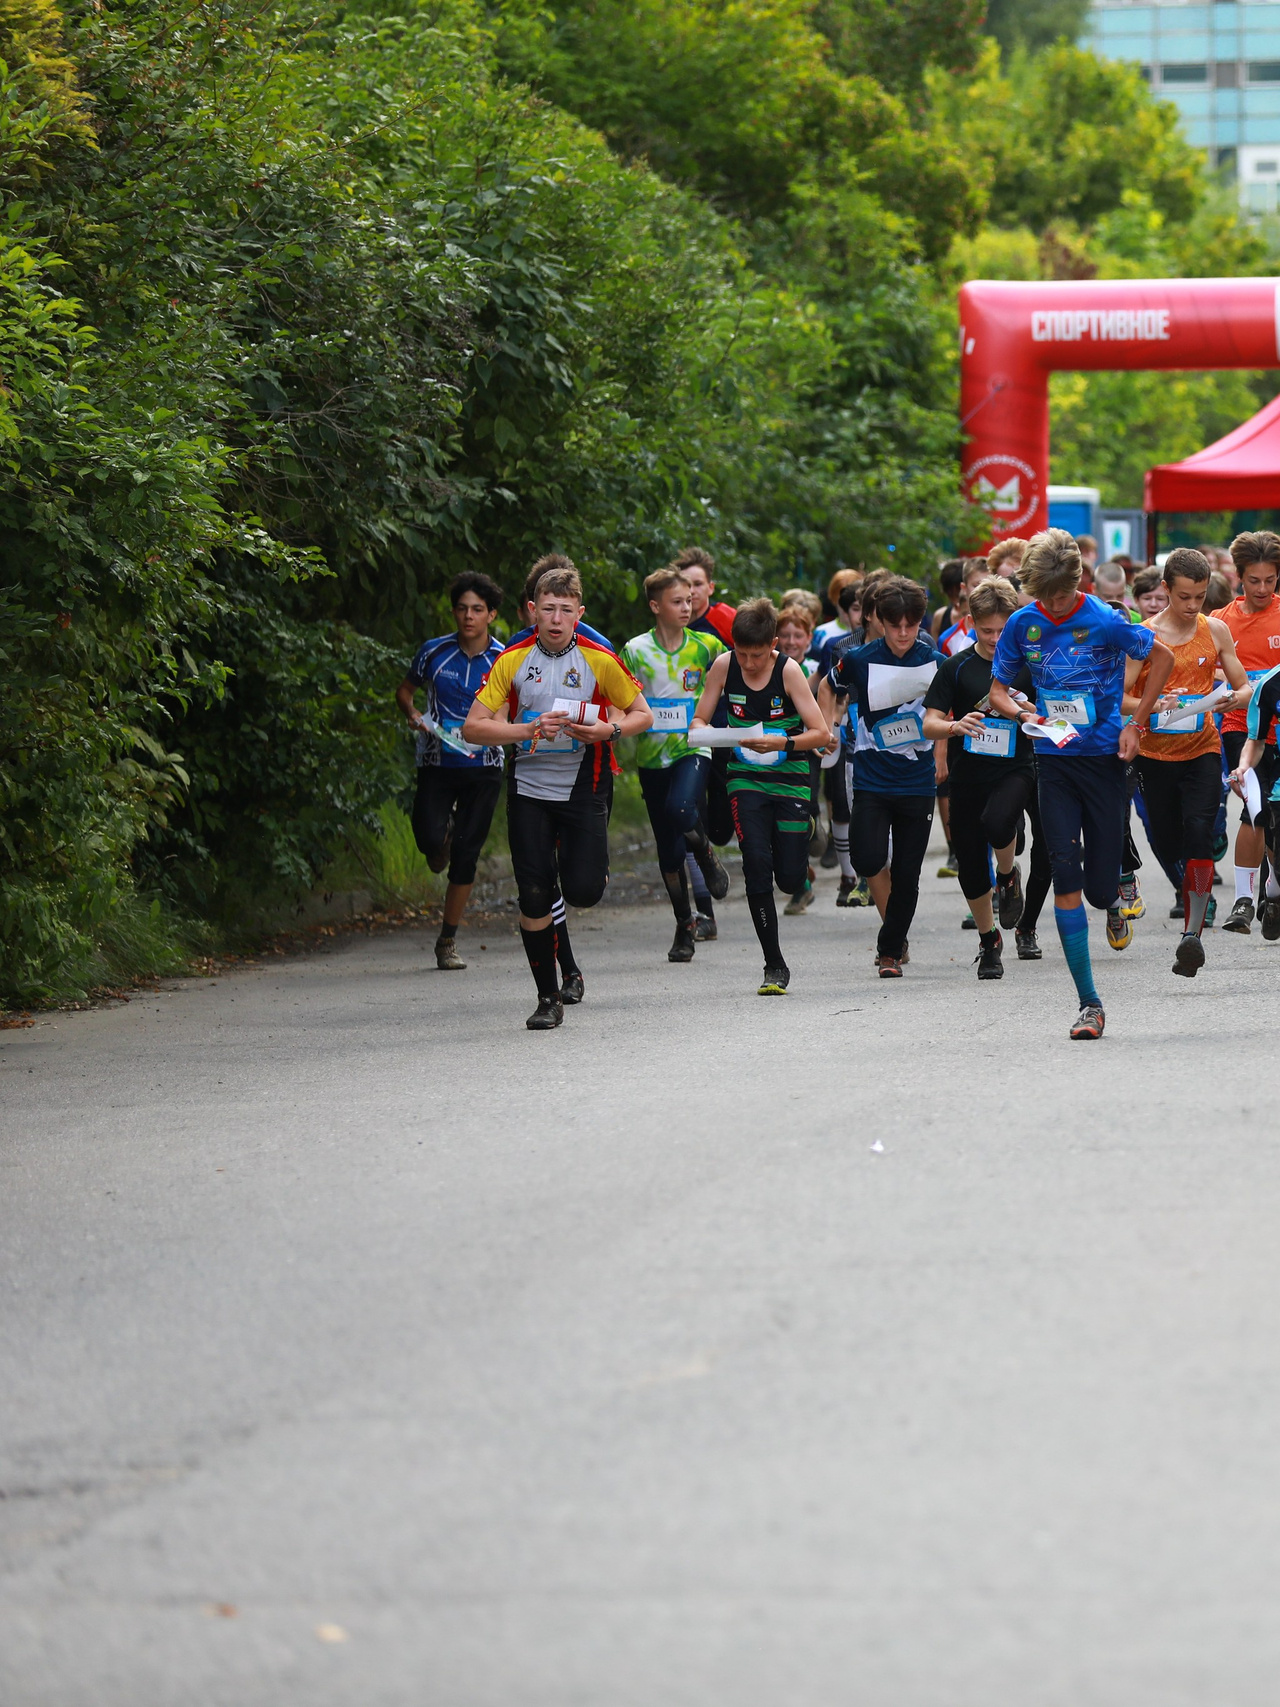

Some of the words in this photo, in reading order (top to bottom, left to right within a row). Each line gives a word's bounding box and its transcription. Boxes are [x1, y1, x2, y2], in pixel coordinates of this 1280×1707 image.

[1031, 309, 1171, 342] СПОРТИВНОЕ
[658, 711, 680, 719] 320.1
[887, 725, 910, 737] 319.1
